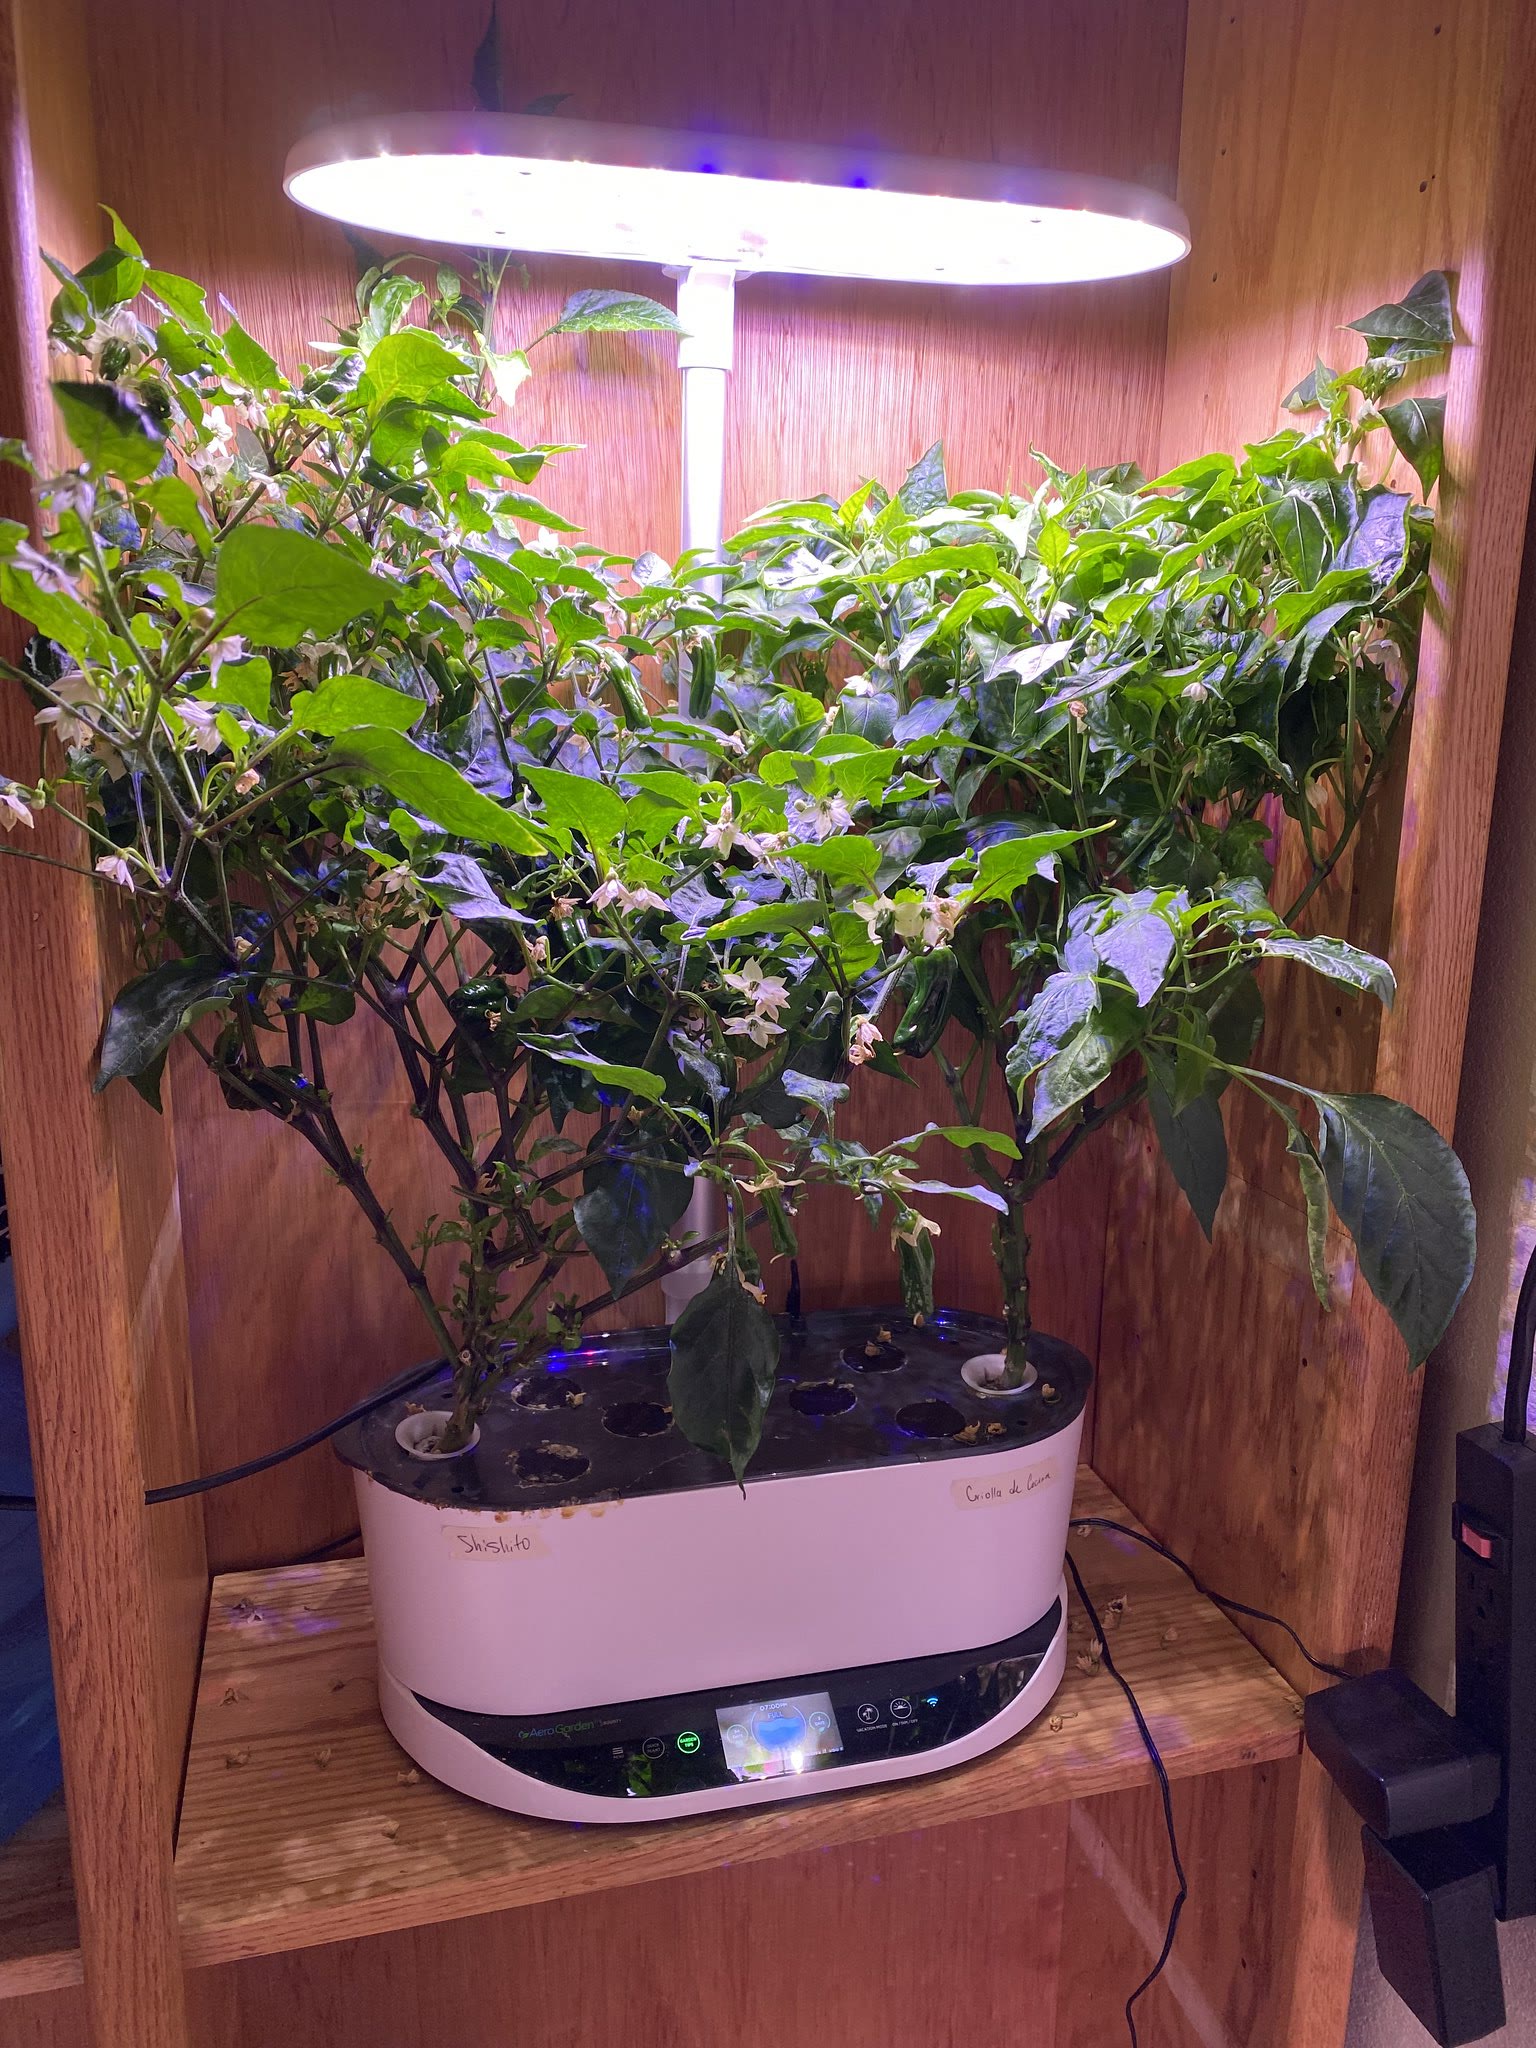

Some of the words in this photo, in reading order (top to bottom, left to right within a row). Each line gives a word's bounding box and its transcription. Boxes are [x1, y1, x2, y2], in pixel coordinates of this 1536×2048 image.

[1009, 1480, 1022, 1495] de
[767, 1711, 784, 1719] FULL
[529, 1721, 595, 1738] AeroGarden
